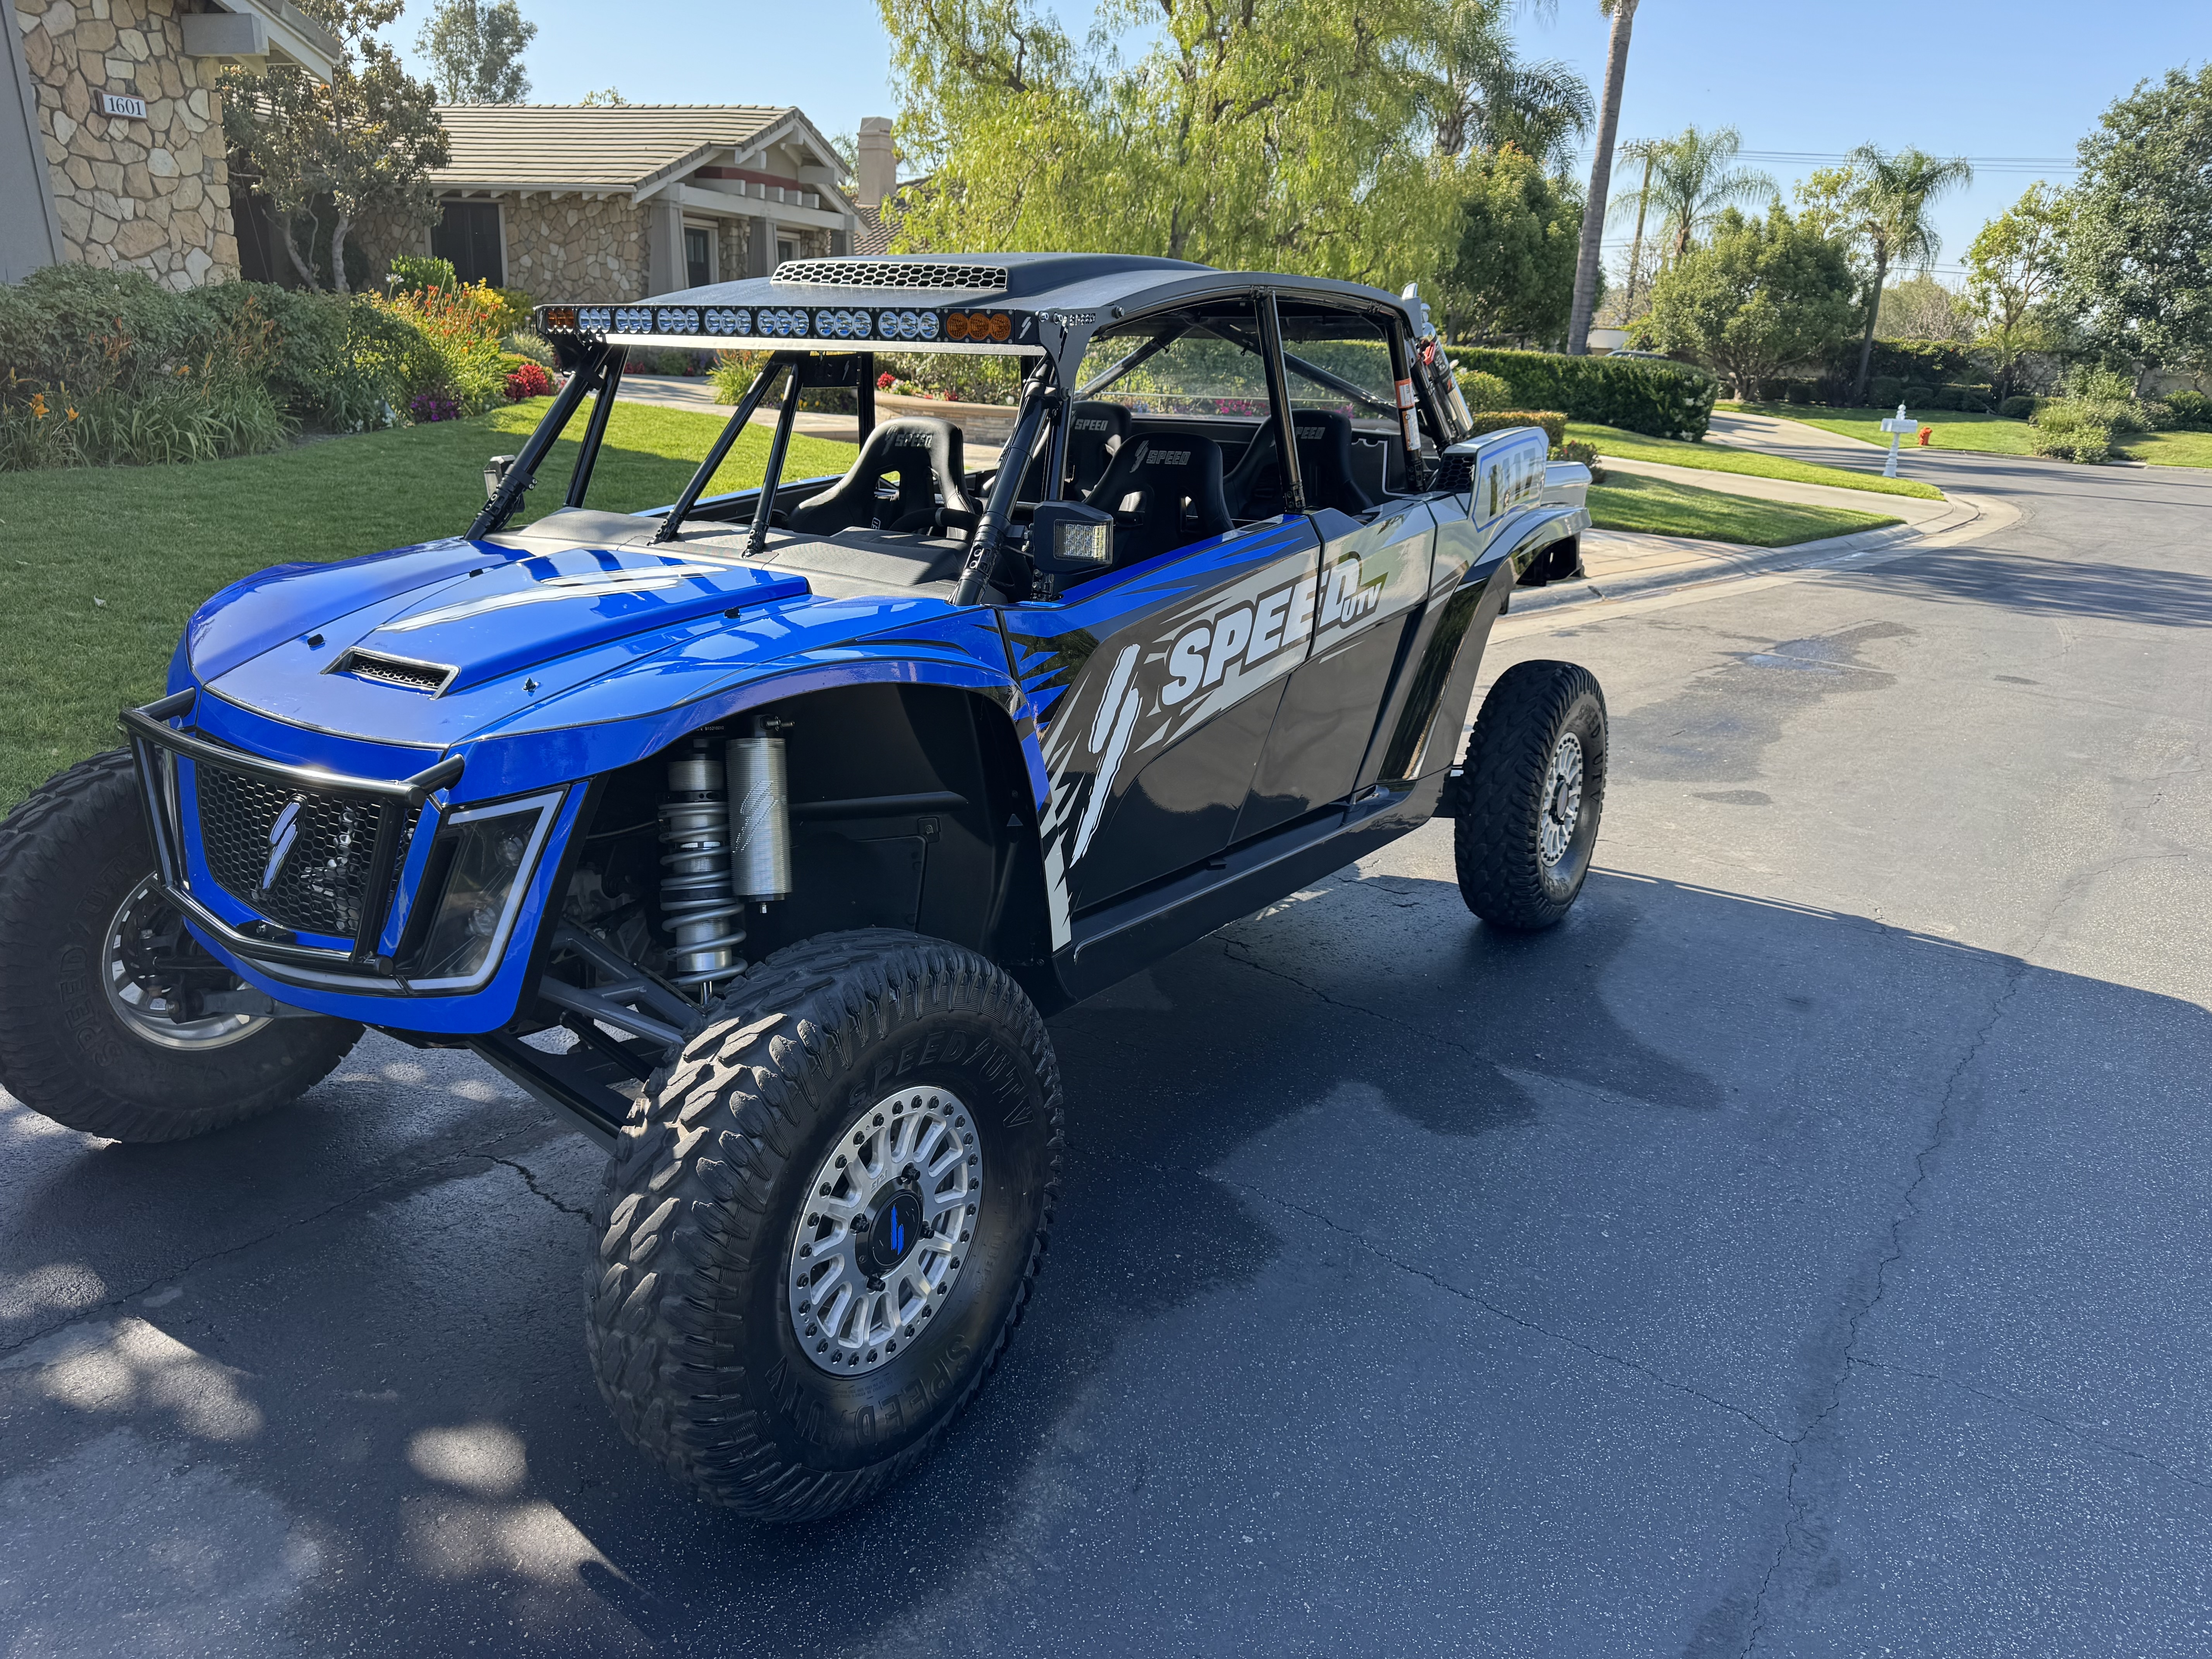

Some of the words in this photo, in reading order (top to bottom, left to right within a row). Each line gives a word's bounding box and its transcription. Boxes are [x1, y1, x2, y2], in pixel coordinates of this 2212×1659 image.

[108, 97, 143, 115] 1601
[895, 433, 932, 448] SPEED
[1075, 419, 1108, 431] SPEED
[1295, 427, 1326, 439] PEED
[1146, 450, 1191, 465] SPEED
[1162, 558, 1360, 706] SPEED
[1341, 582, 1381, 622] UTV
[1589, 750, 1603, 804] UTV
[59, 946, 123, 1068] SPEED
[847, 1030, 967, 1108] SPEED
[979, 1045, 1036, 1128] UTV
[854, 1334, 972, 1446] SPEED
